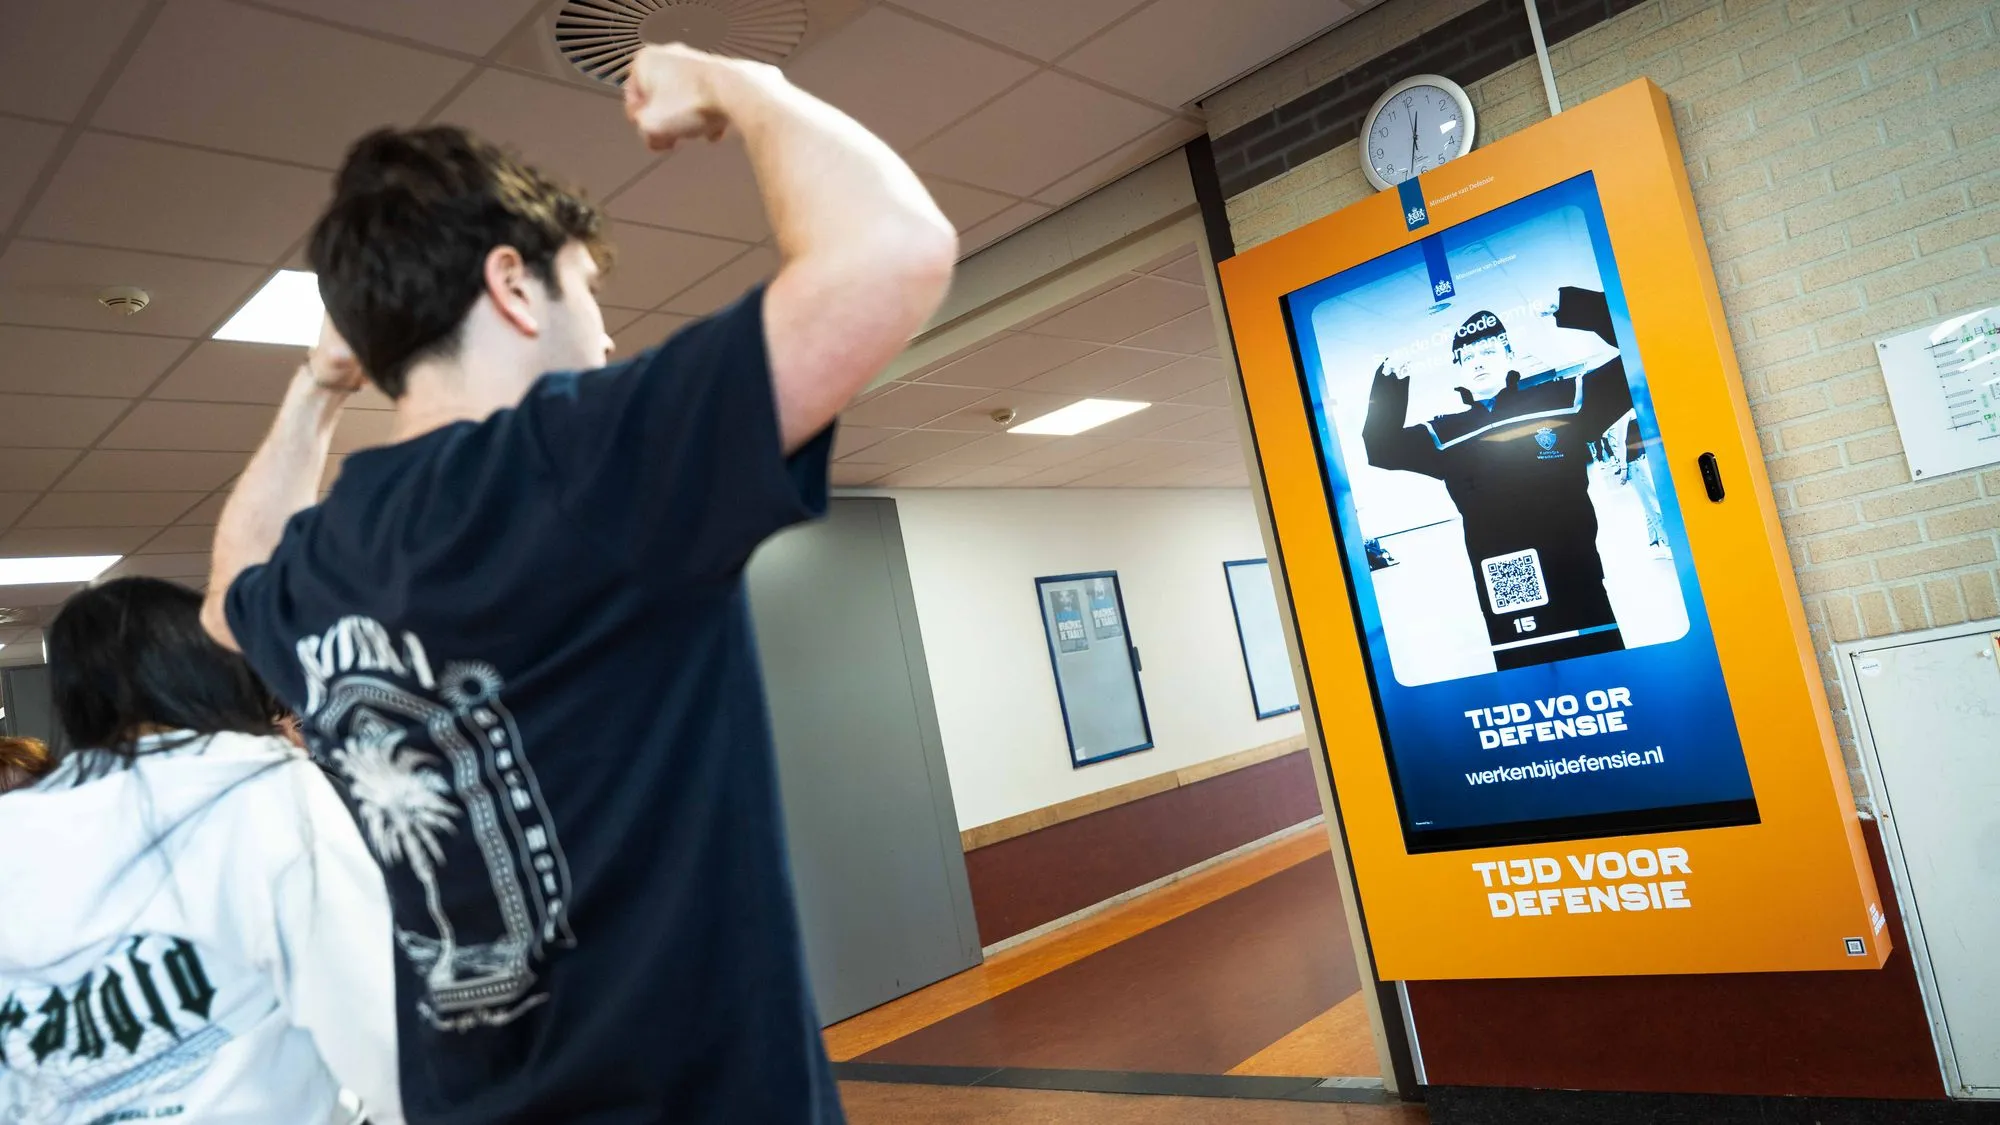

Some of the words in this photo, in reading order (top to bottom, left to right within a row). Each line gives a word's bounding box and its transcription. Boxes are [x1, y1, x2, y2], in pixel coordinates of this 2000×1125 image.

[1438, 99, 1448, 112] 2
[1429, 190, 1459, 207] Ministerie
[1469, 175, 1495, 191] Defensie
[1456, 315, 1497, 338] code
[1513, 616, 1537, 634] 15
[1464, 702, 1532, 729] TIJD
[1479, 711, 1628, 750] DEFENSIE
[1465, 746, 1664, 786] werkenbijdefensie.nl
[1472, 857, 1562, 888] TIJD
[1567, 847, 1693, 881] VOOR
[1487, 881, 1691, 918] DEFENSIE
